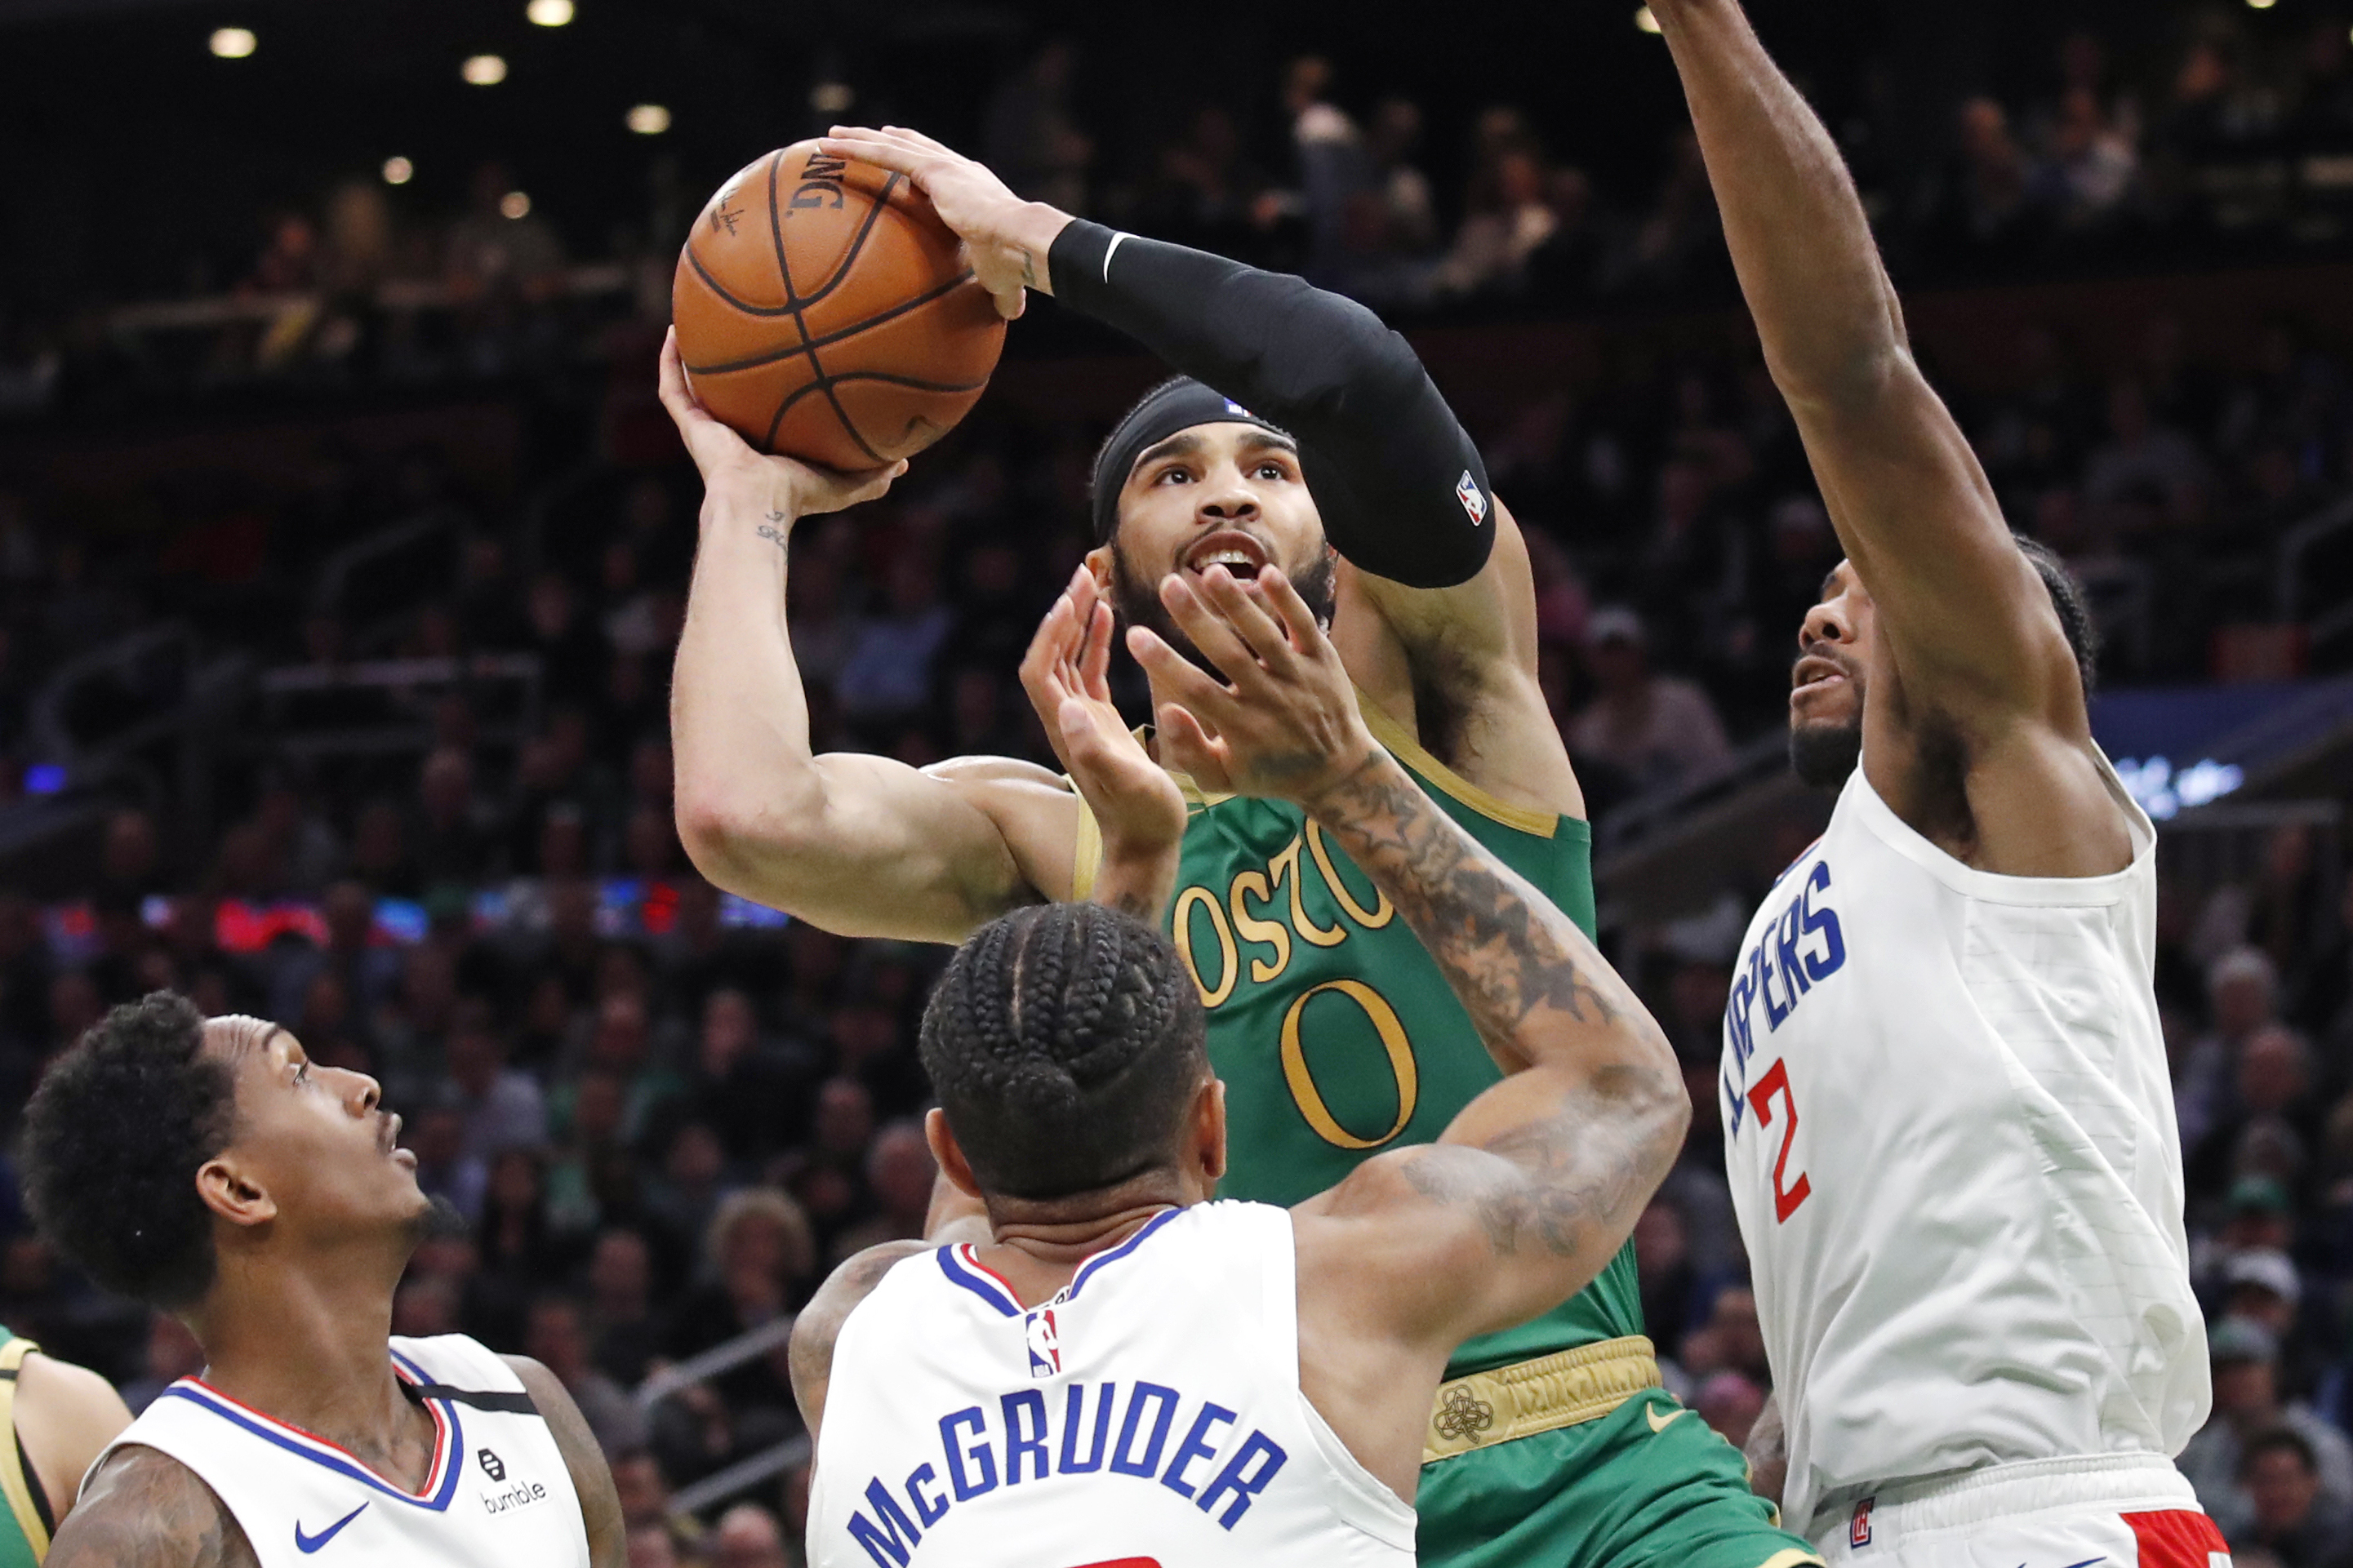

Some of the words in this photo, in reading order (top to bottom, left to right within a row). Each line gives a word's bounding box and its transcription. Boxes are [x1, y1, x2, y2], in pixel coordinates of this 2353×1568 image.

[1172, 815, 1394, 1009] OSTO
[1280, 978, 1418, 1148] 0
[1746, 1056, 1812, 1224] 2
[480, 1480, 546, 1514] bumble
[847, 1380, 1288, 1568] McGRUDER
